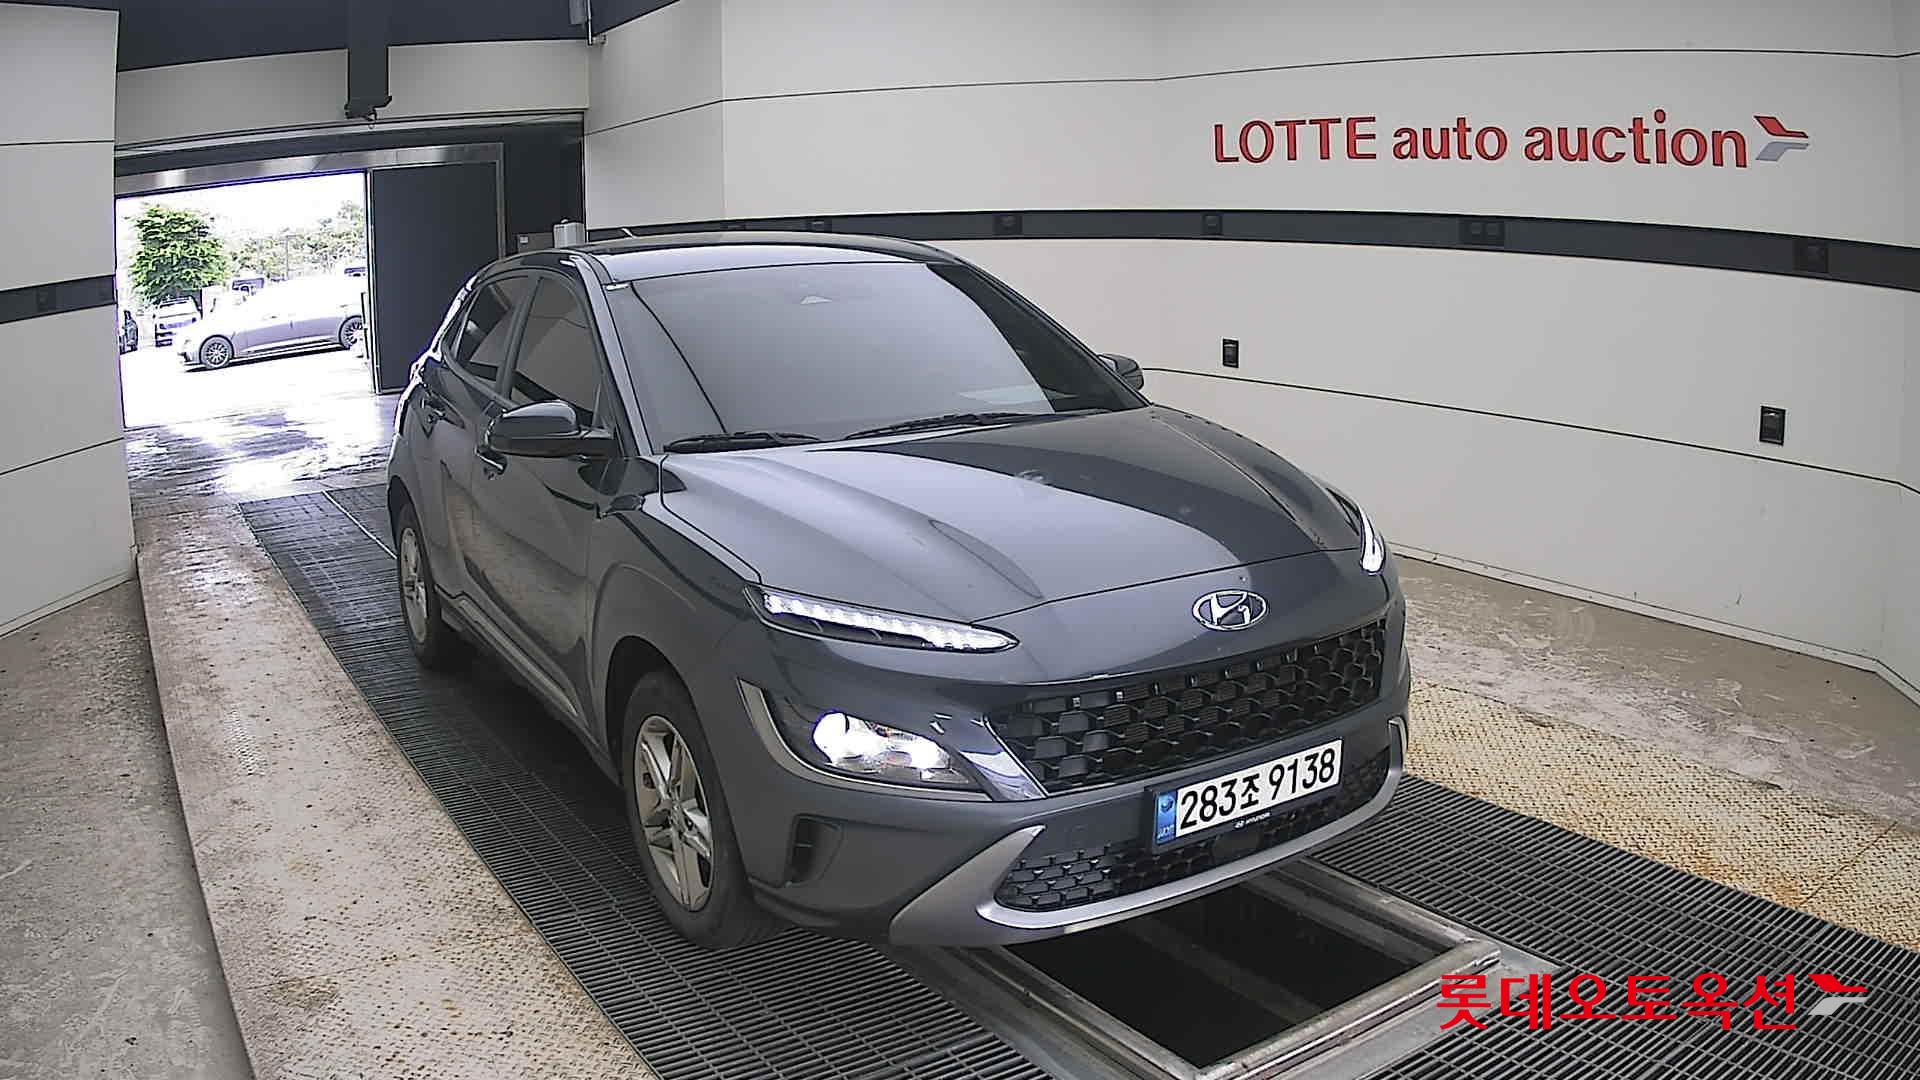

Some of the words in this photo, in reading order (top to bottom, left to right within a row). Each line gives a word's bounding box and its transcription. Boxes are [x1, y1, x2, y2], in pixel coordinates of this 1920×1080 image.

[1214, 116, 1376, 163] LOTTE
[1392, 117, 1508, 161] auto
[1523, 109, 1747, 168] auction
[1180, 774, 1259, 829] 283조
[1269, 748, 1336, 800] 9138
